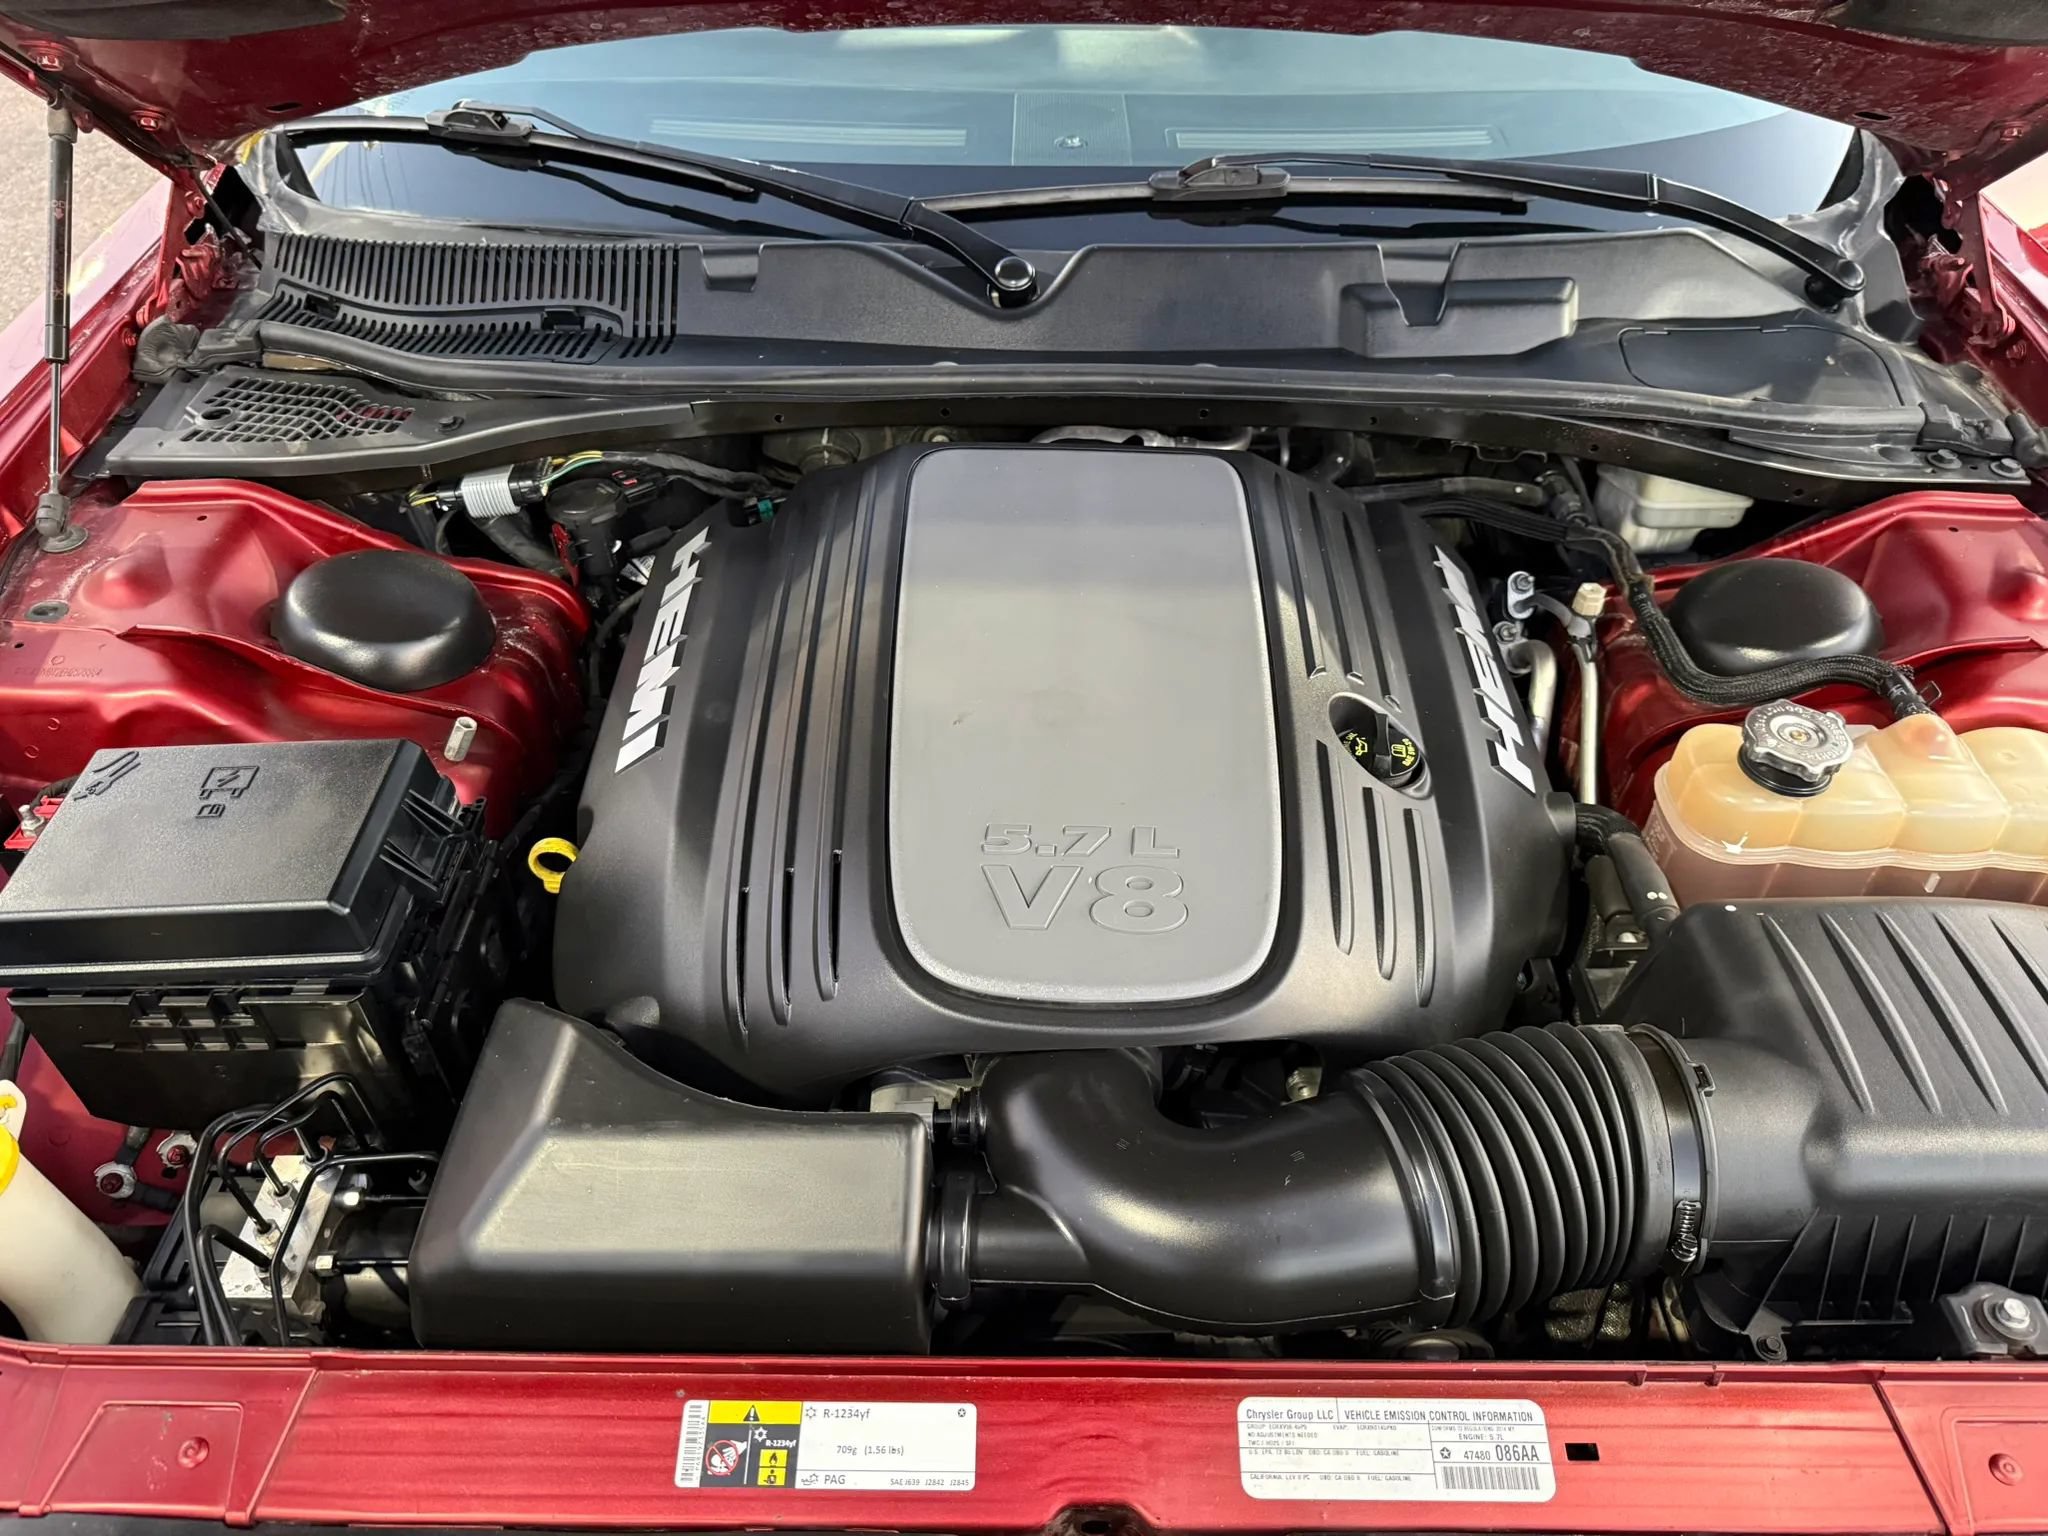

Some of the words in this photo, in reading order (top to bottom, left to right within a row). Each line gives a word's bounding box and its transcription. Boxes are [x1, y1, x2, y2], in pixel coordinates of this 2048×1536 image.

[614, 525, 712, 775] HEMI
[1433, 545, 1537, 798] HEMI
[981, 864, 1189, 935] V8
[823, 1408, 871, 1421] R-1234yf
[1246, 1409, 1283, 1421] Chrysler
[1286, 1409, 1314, 1421] Group
[1316, 1410, 1334, 1420] LLC
[1344, 1410, 1381, 1420] VEHICLE
[1384, 1410, 1426, 1420] EMISSION
[1429, 1411, 1470, 1421] CONTROL
[1473, 1411, 1533, 1422] INFORMATION
[765, 1439, 797, 1448] R-1234yf
[836, 1445, 858, 1456] 709g
[864, 1445, 886, 1456] (1.56
[888, 1445, 905, 1456] lbs)
[1463, 1450, 1491, 1460] 47480
[1495, 1444, 1540, 1461] 086AA
[824, 1474, 846, 1485] PAG
[890, 1478, 903, 1486] SAE
[904, 1478, 920, 1486] J639
[925, 1478, 945, 1486] J2842
